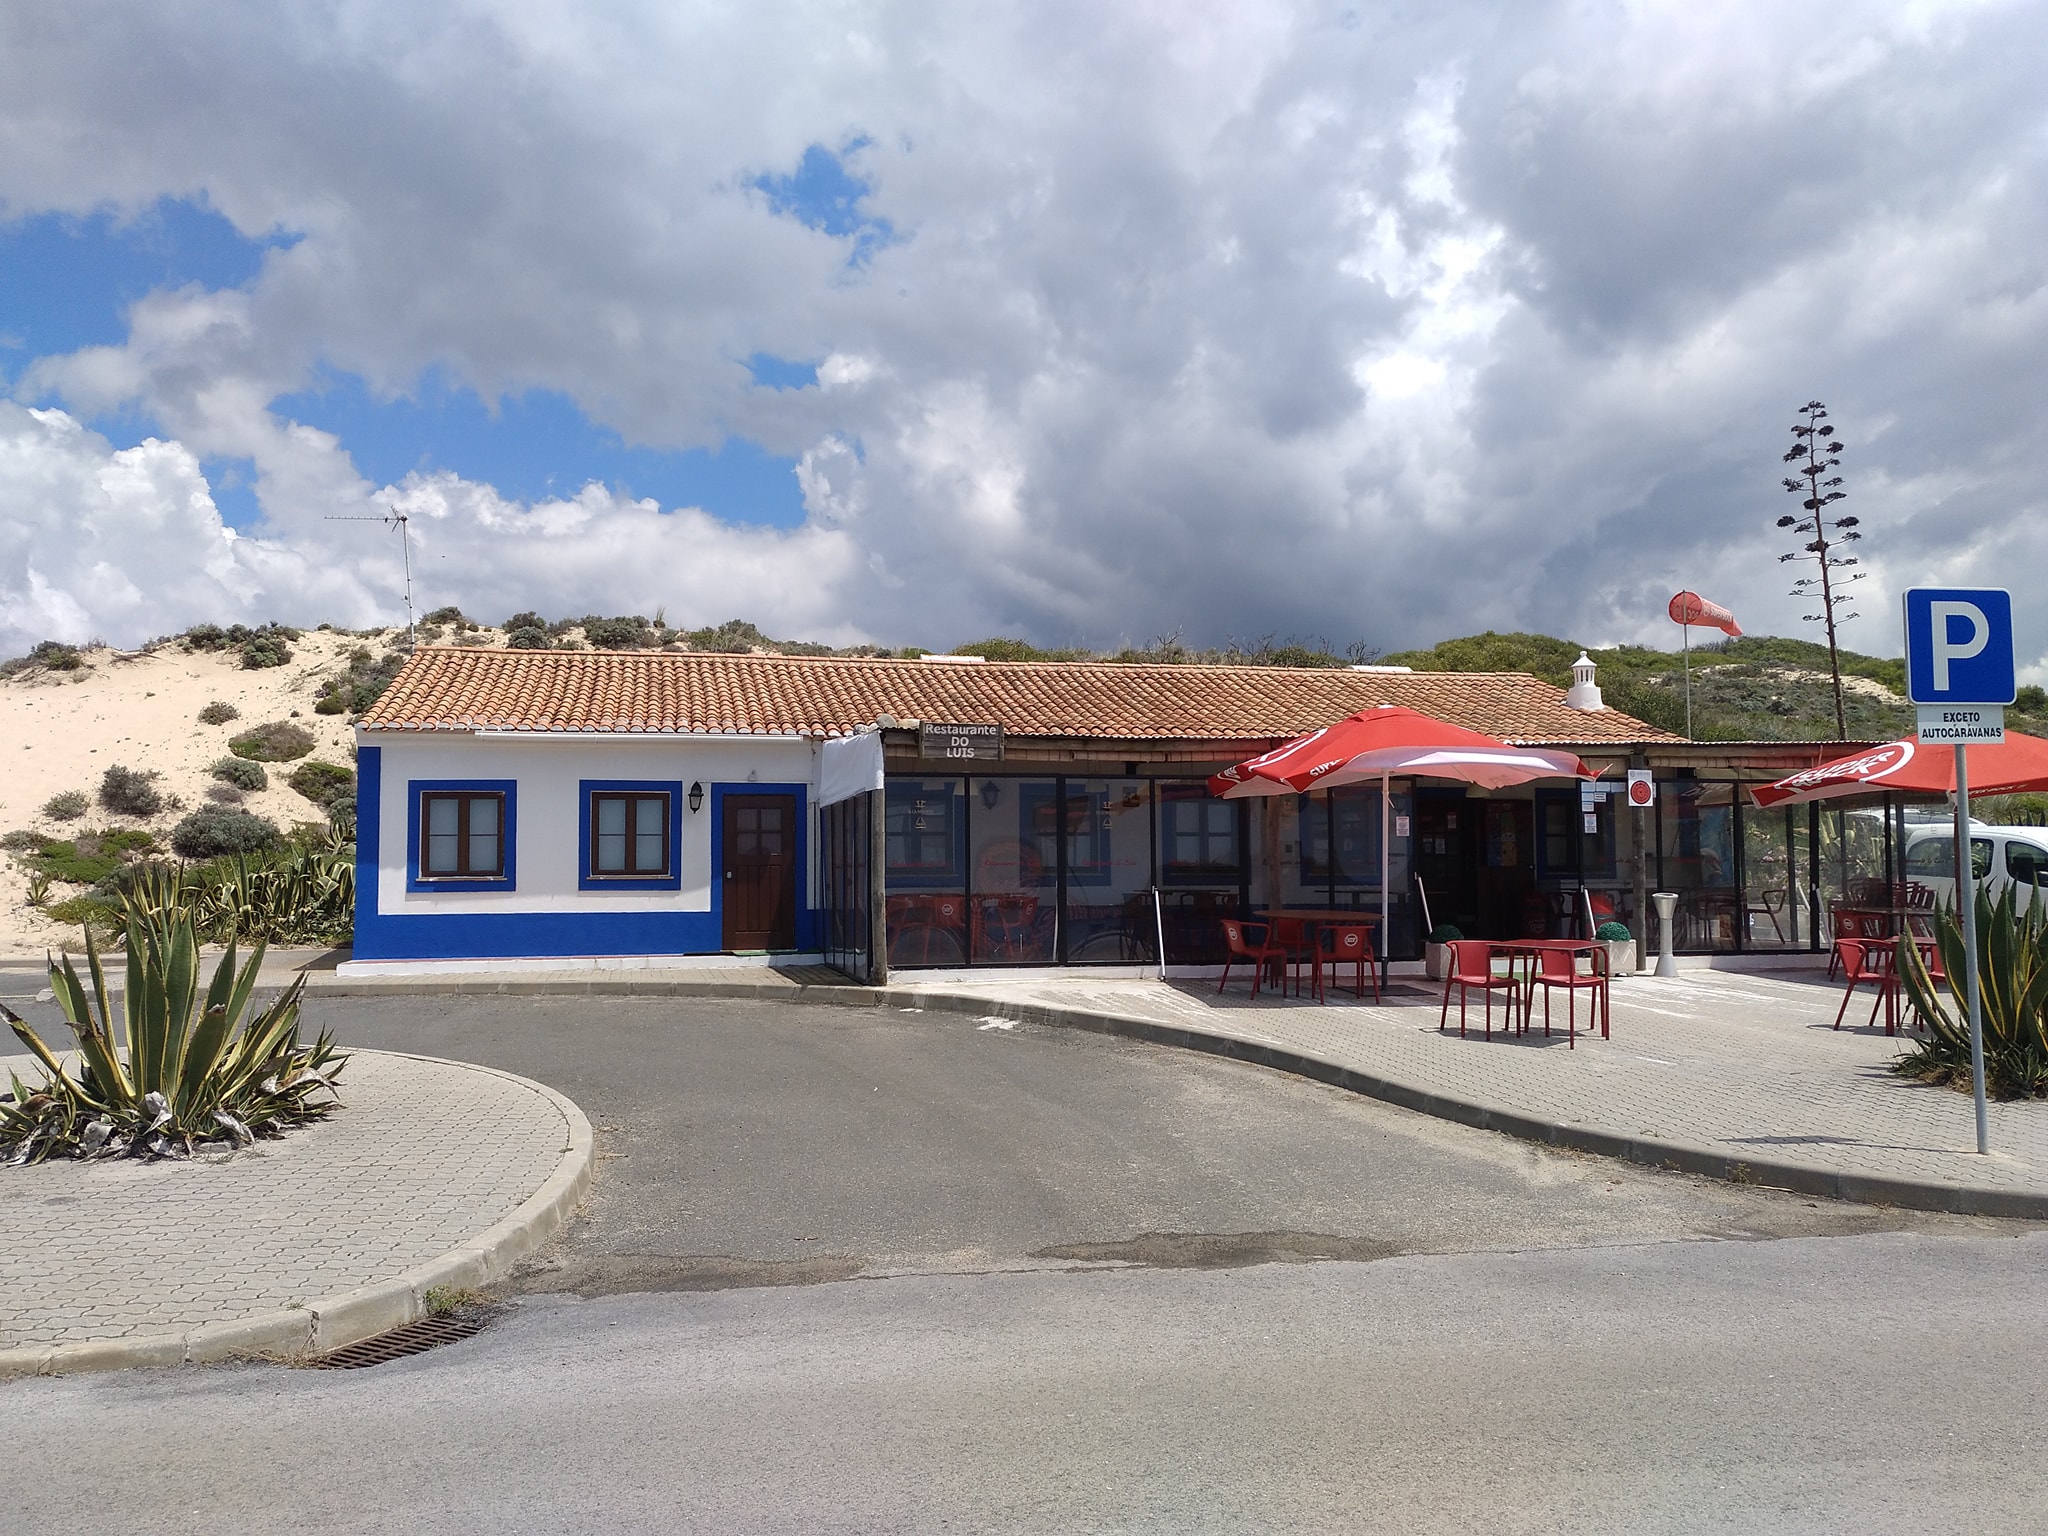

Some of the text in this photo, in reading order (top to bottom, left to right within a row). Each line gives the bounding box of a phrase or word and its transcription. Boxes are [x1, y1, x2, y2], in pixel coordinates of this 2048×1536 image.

[1930, 601, 1990, 691] P
[1943, 712, 1980, 723] EXCETO
[925, 724, 997, 735] Restaurante
[1921, 727, 2002, 738] AUTOCARAVANAS
[951, 736, 970, 747] DO
[946, 747, 975, 758] LUIS
